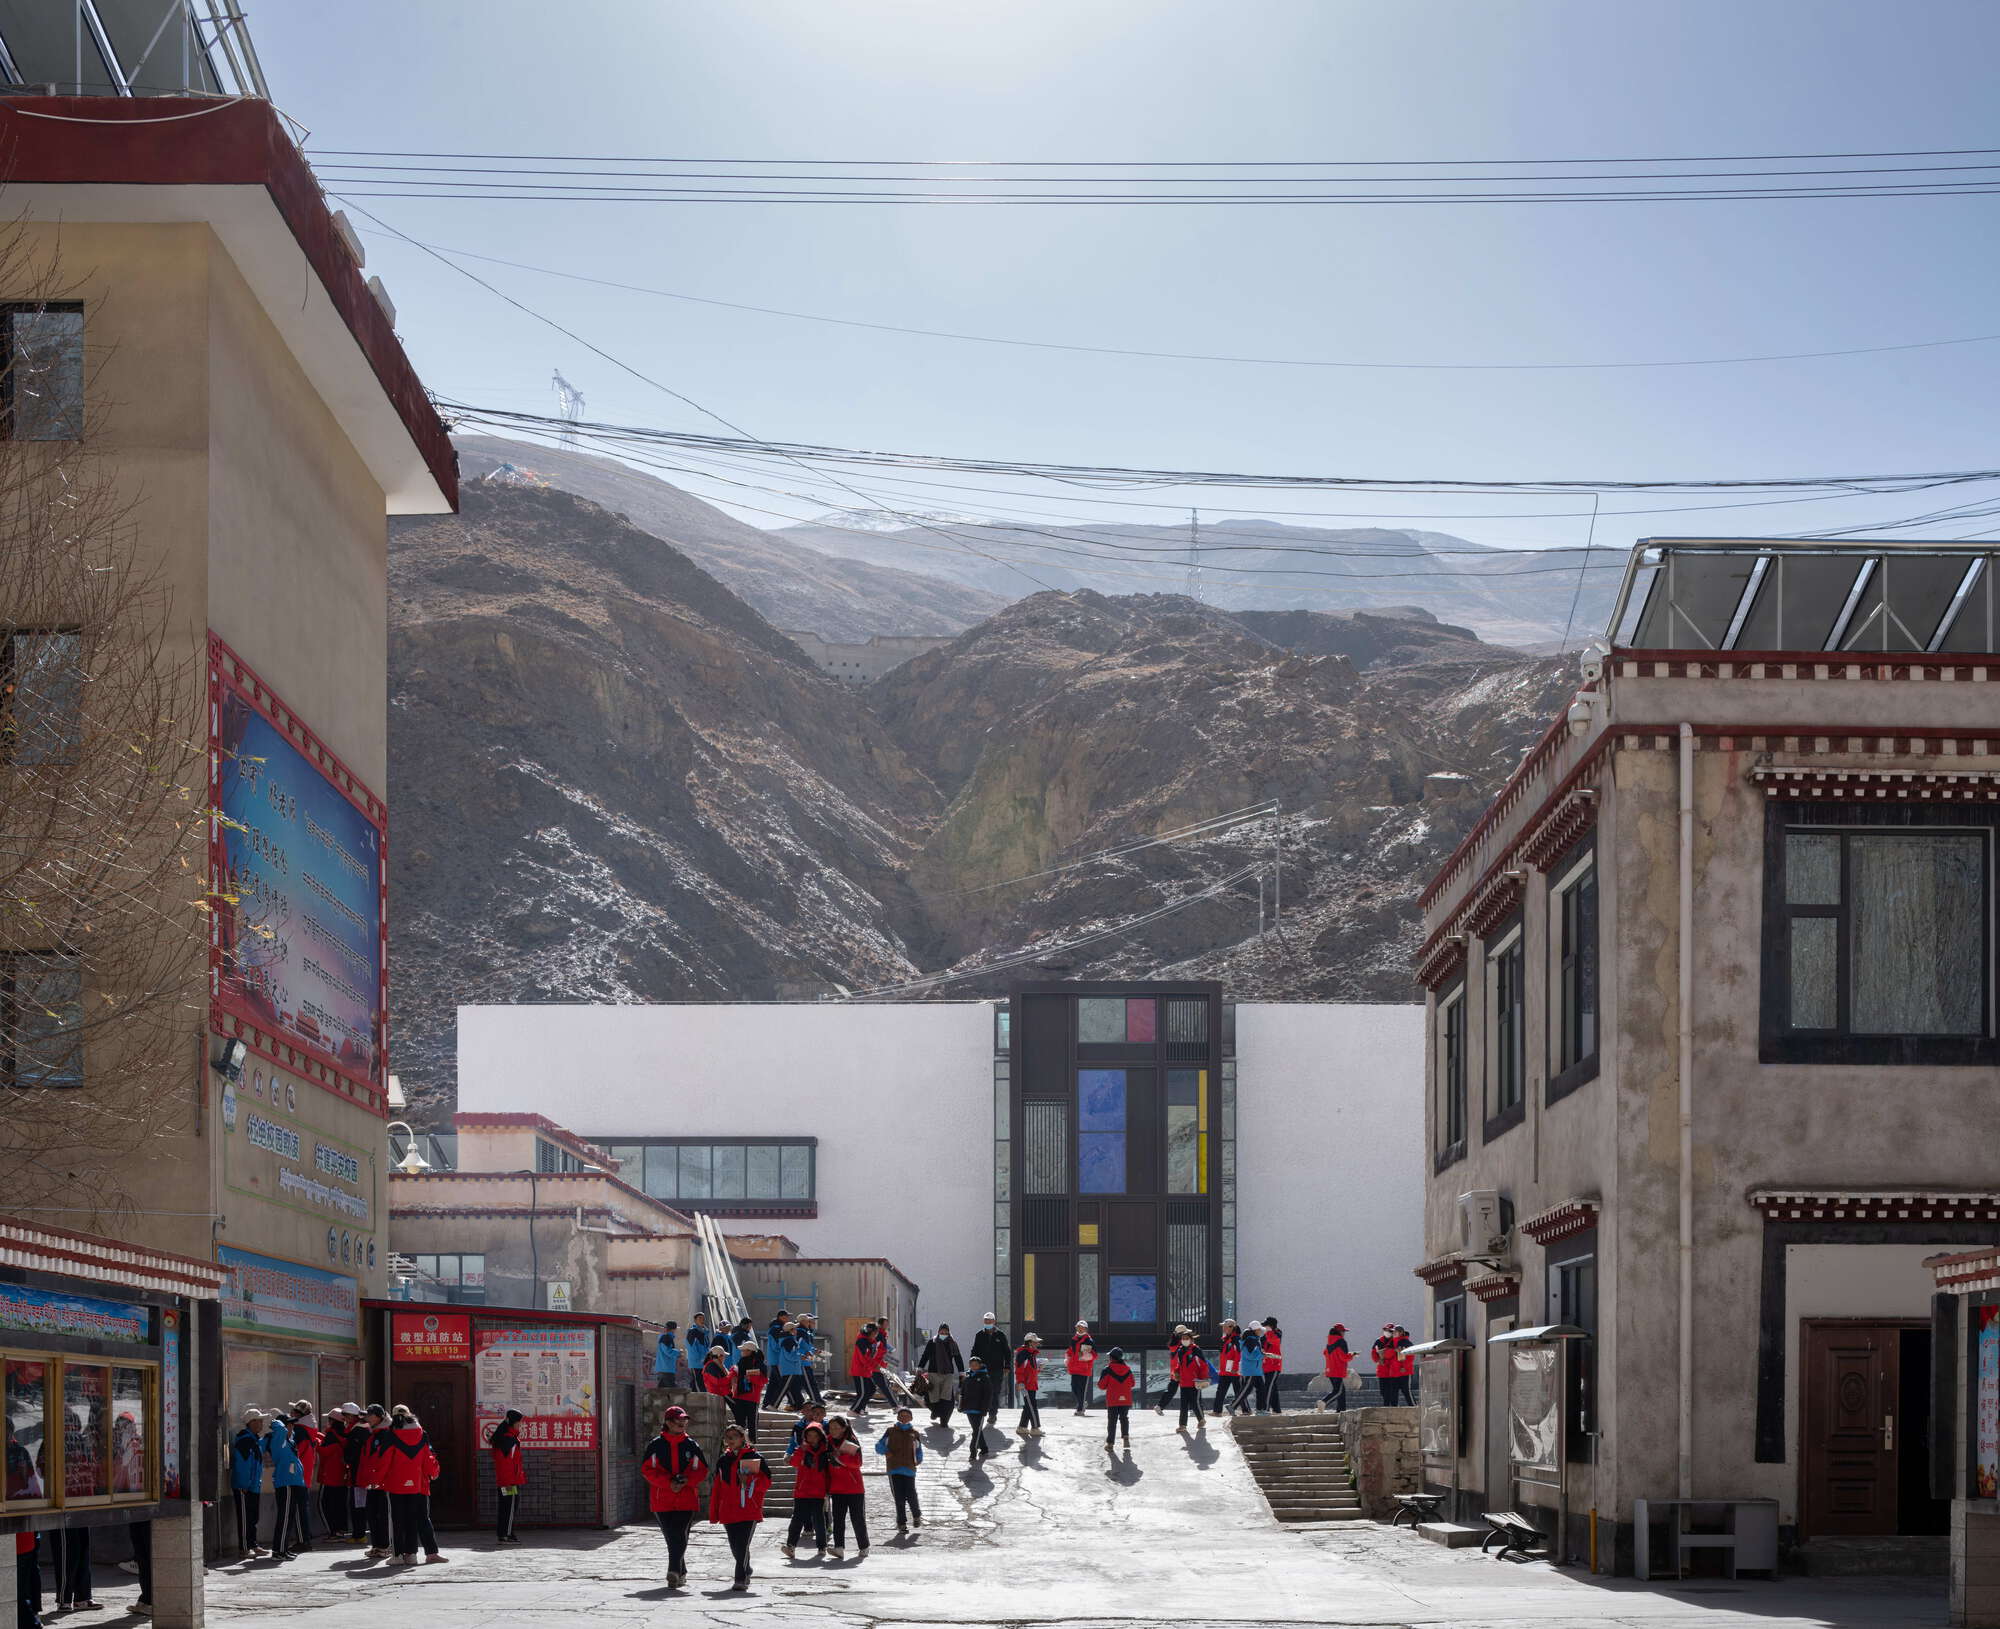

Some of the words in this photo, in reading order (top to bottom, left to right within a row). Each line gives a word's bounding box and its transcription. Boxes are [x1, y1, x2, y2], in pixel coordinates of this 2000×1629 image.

[315, 1143, 359, 1185] 共建平安校园
[400, 1331, 463, 1343] 微型消防站
[405, 1346, 459, 1355] 火警电话:119
[553, 1421, 593, 1440] 禁止停车
